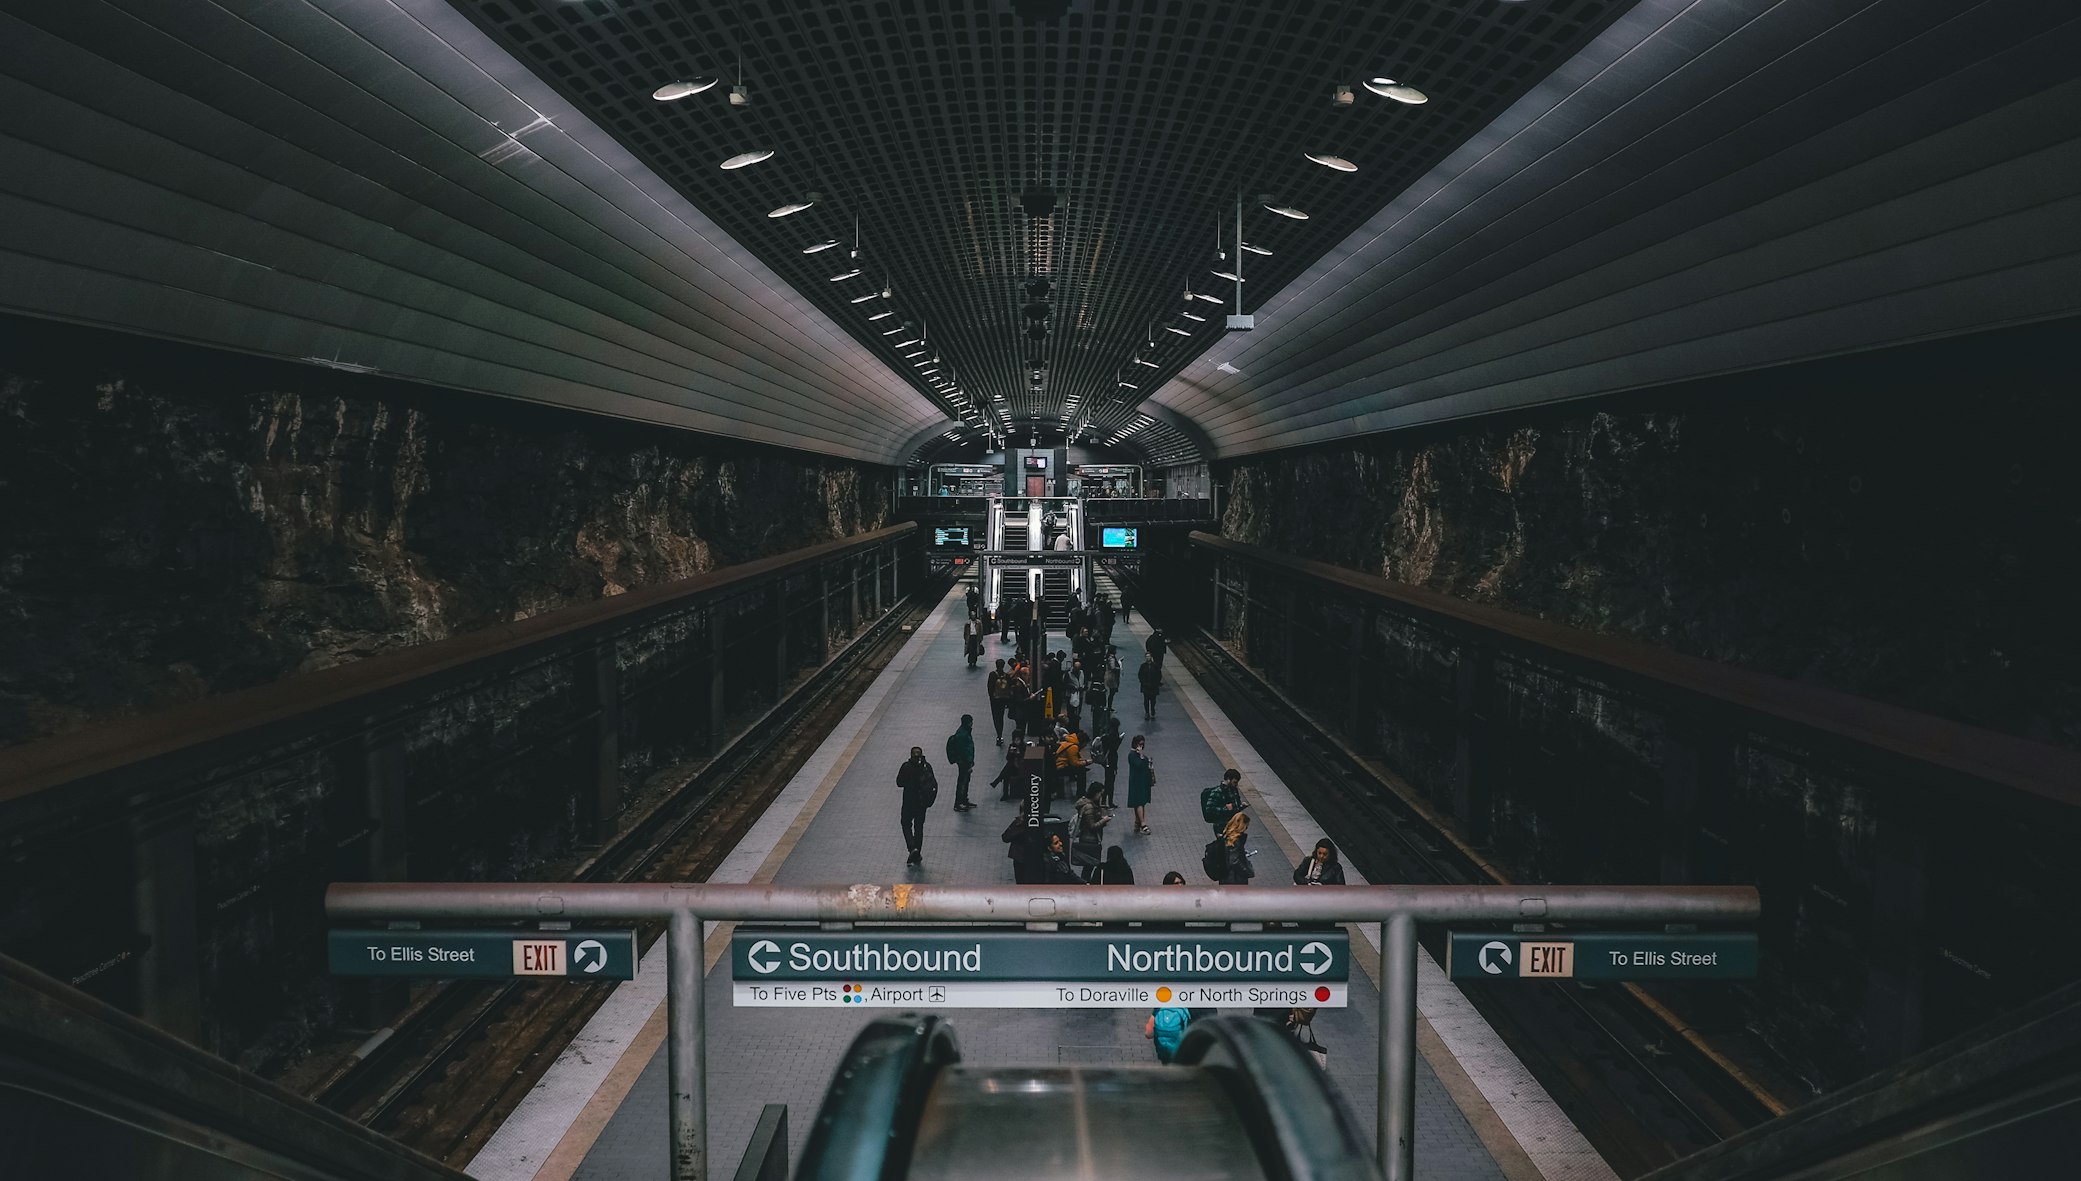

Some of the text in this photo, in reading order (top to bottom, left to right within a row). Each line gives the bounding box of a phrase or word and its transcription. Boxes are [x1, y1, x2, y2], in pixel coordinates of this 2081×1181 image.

[1028, 774, 1041, 827] Directory
[367, 947, 475, 962] To Ellis Street
[523, 945, 558, 971] EXIT
[789, 943, 981, 972] Southbound
[1108, 944, 1293, 972] Northbound
[1531, 946, 1566, 973] EXIT
[1609, 951, 1717, 966] To Ellis Street
[750, 987, 768, 1001] To
[774, 987, 807, 1001] Five
[812, 987, 837, 1001] Pts
[1056, 988, 1307, 1005] To Doraville or North Springs
